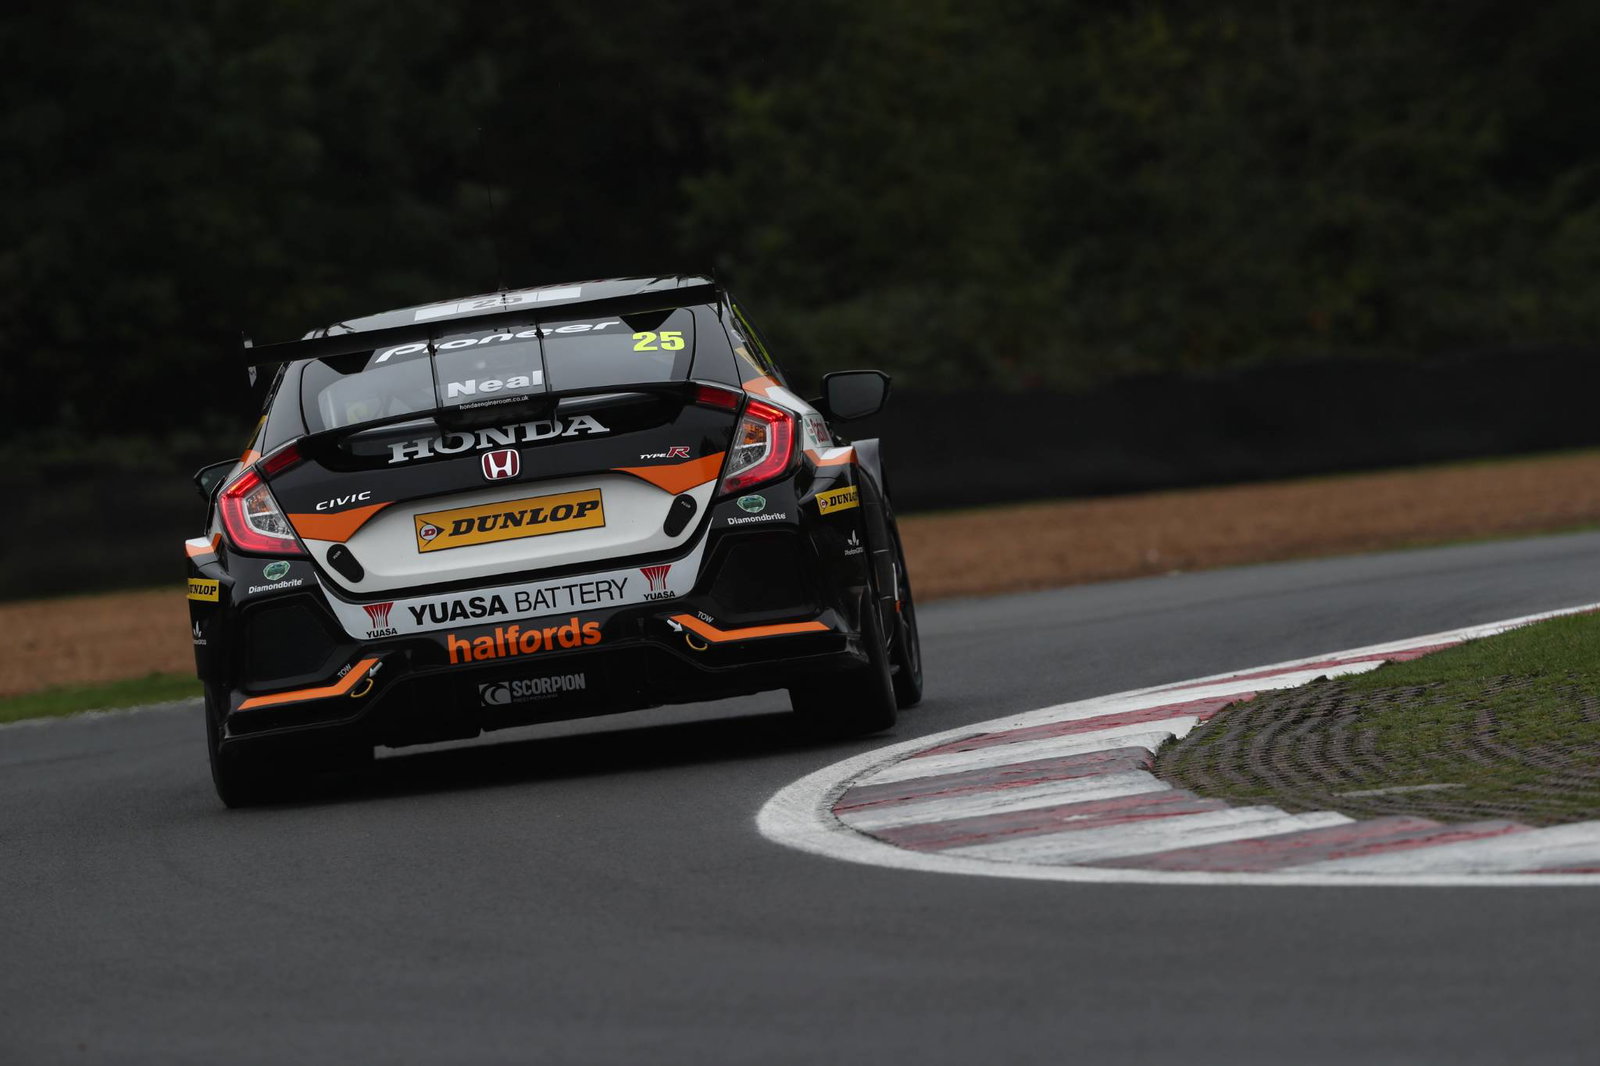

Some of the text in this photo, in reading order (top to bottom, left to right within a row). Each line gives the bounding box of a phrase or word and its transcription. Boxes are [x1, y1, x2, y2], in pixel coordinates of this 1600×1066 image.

[632, 331, 685, 352] 25
[448, 371, 543, 399] Neal
[388, 415, 610, 464] HONDA
[667, 446, 690, 458] R
[315, 491, 371, 511] CIVIC
[448, 500, 600, 538] DUNLOP
[727, 513, 786, 526] Diamondbrite
[248, 578, 303, 594] Diamondbrite
[643, 591, 676, 601] YUASA
[408, 577, 628, 626] YUASA BATTERY
[697, 611, 714, 624] TOW
[366, 627, 398, 639] YUASA
[447, 617, 602, 665] halfords
[337, 663, 352, 678] TOW
[511, 672, 586, 697] SCORPION
